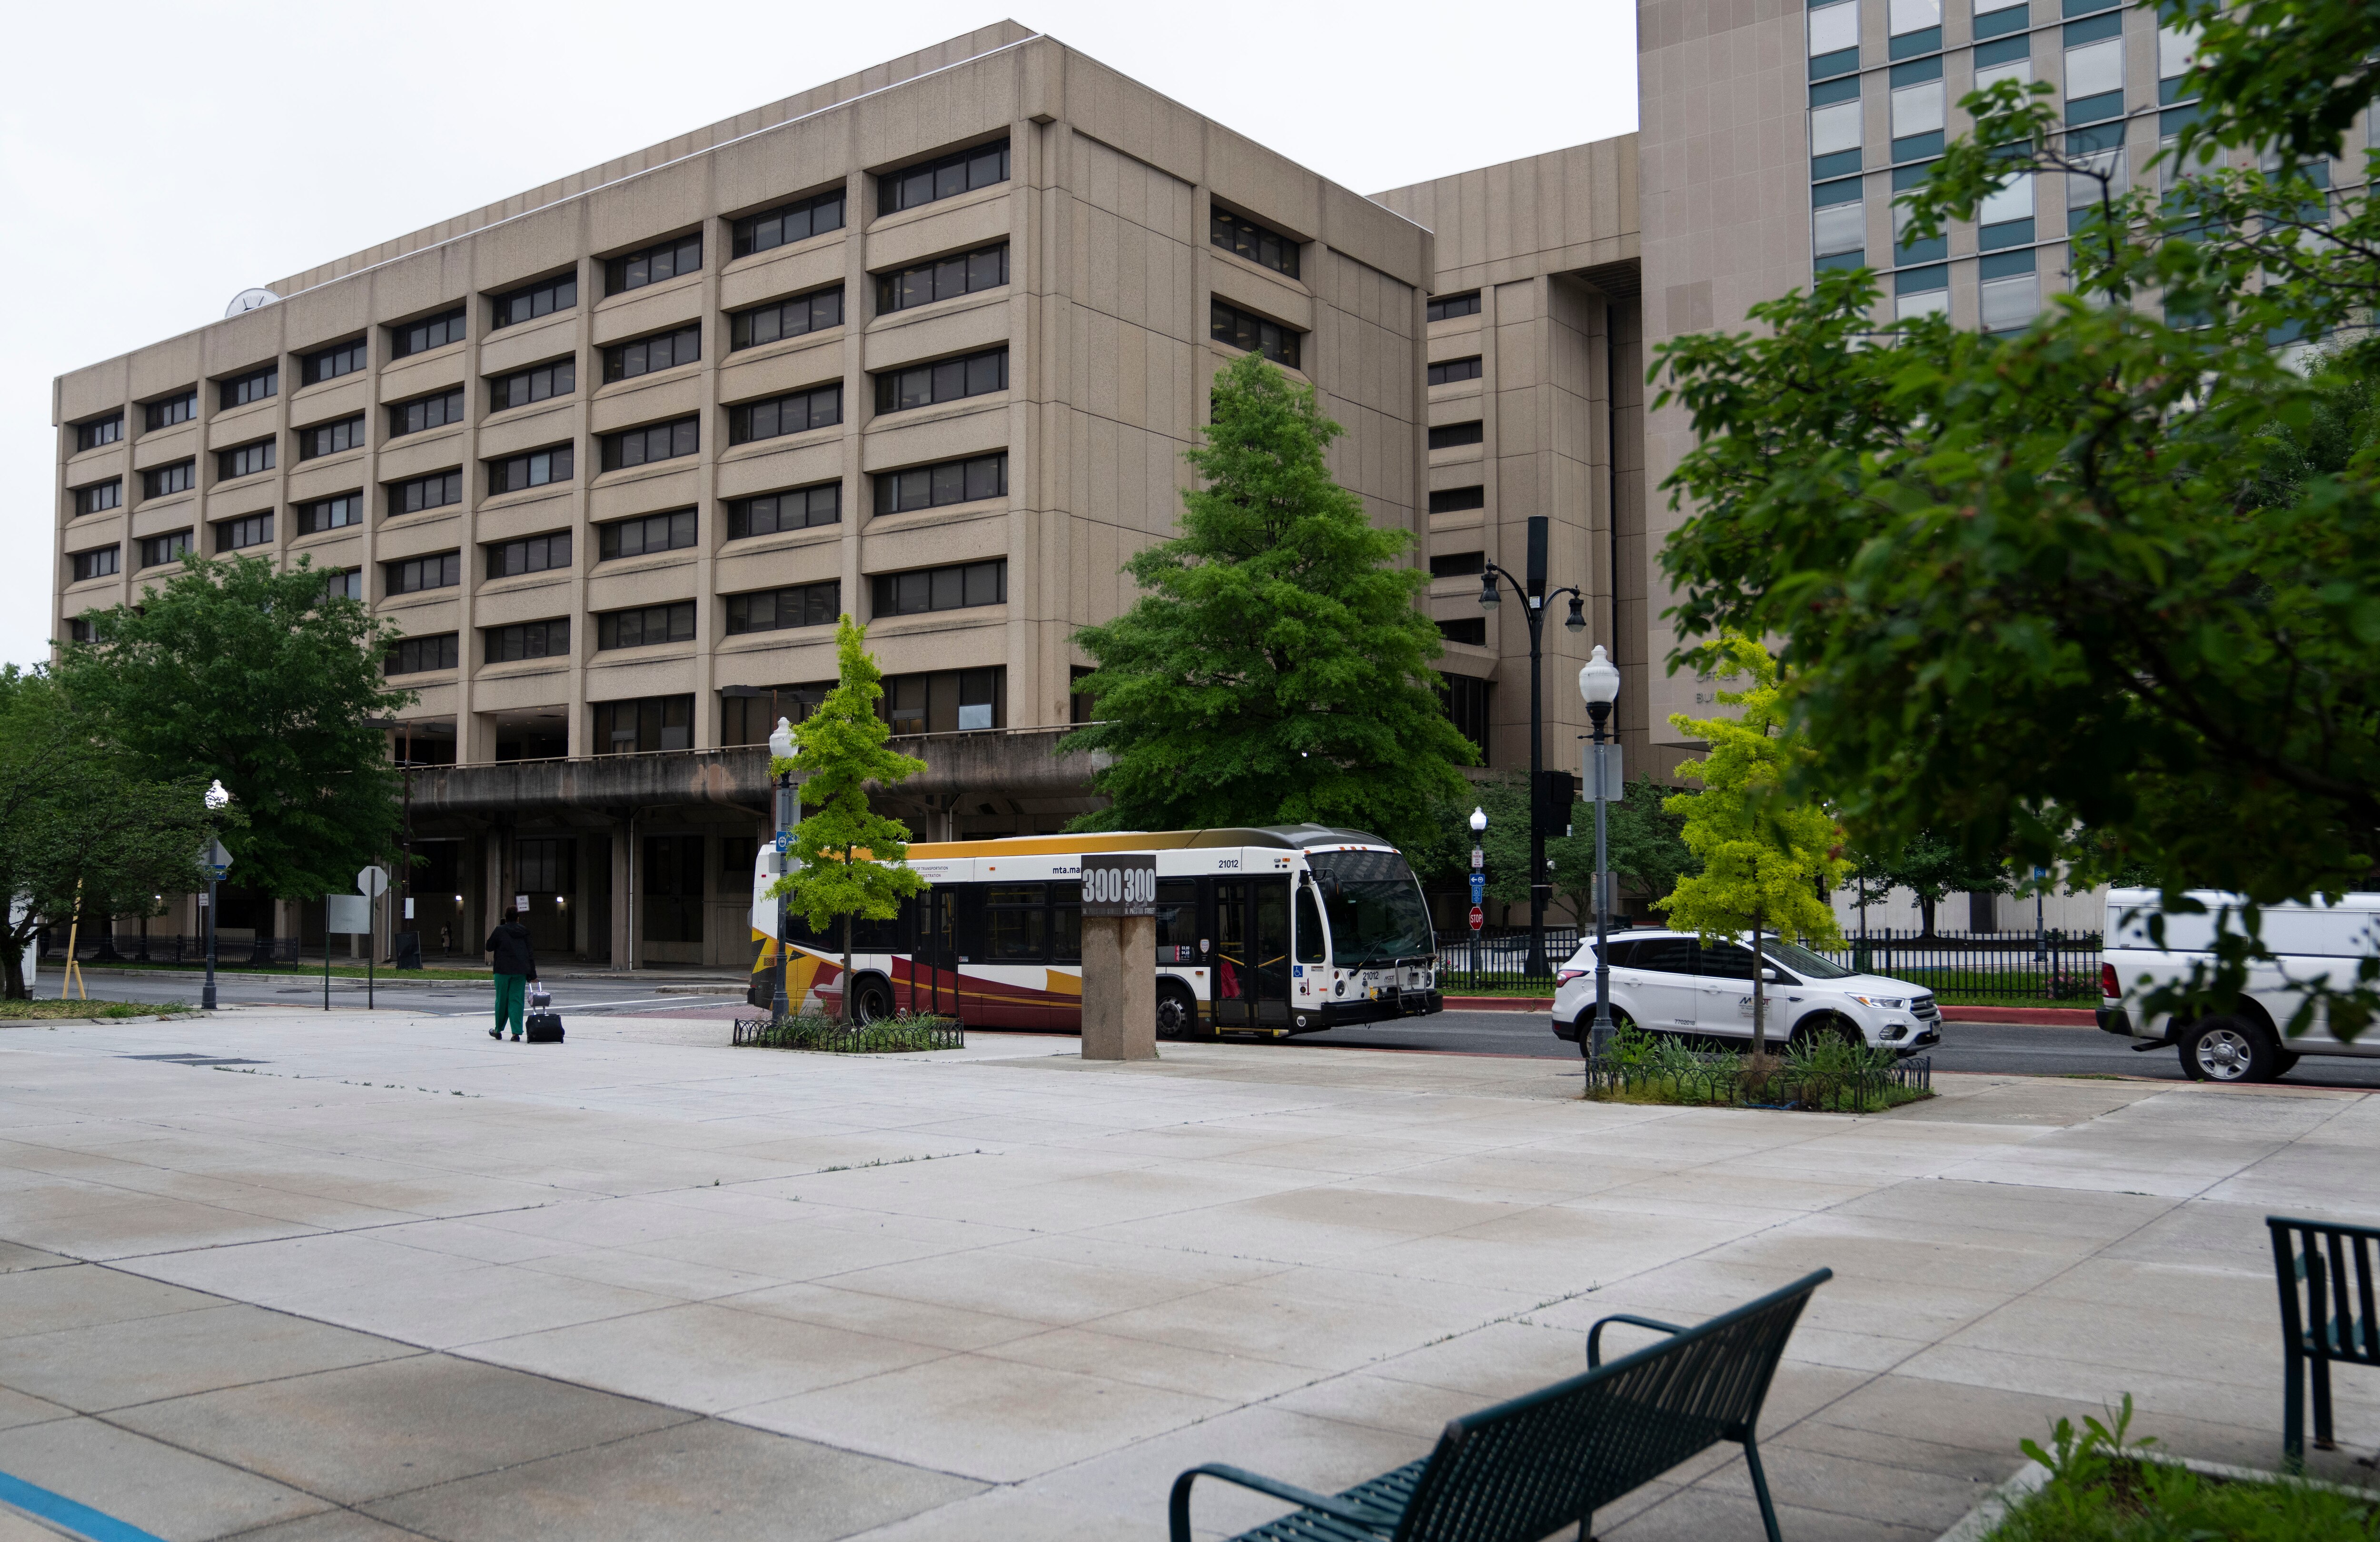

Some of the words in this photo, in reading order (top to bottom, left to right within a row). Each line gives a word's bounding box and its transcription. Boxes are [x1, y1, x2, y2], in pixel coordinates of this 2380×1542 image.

[1219, 860, 1238, 868] 21012
[1082, 868, 1121, 902] 300
[1124, 868, 1155, 902] 300
[1470, 914, 1482, 923] STOP
[1363, 971, 1378, 980] 21012
